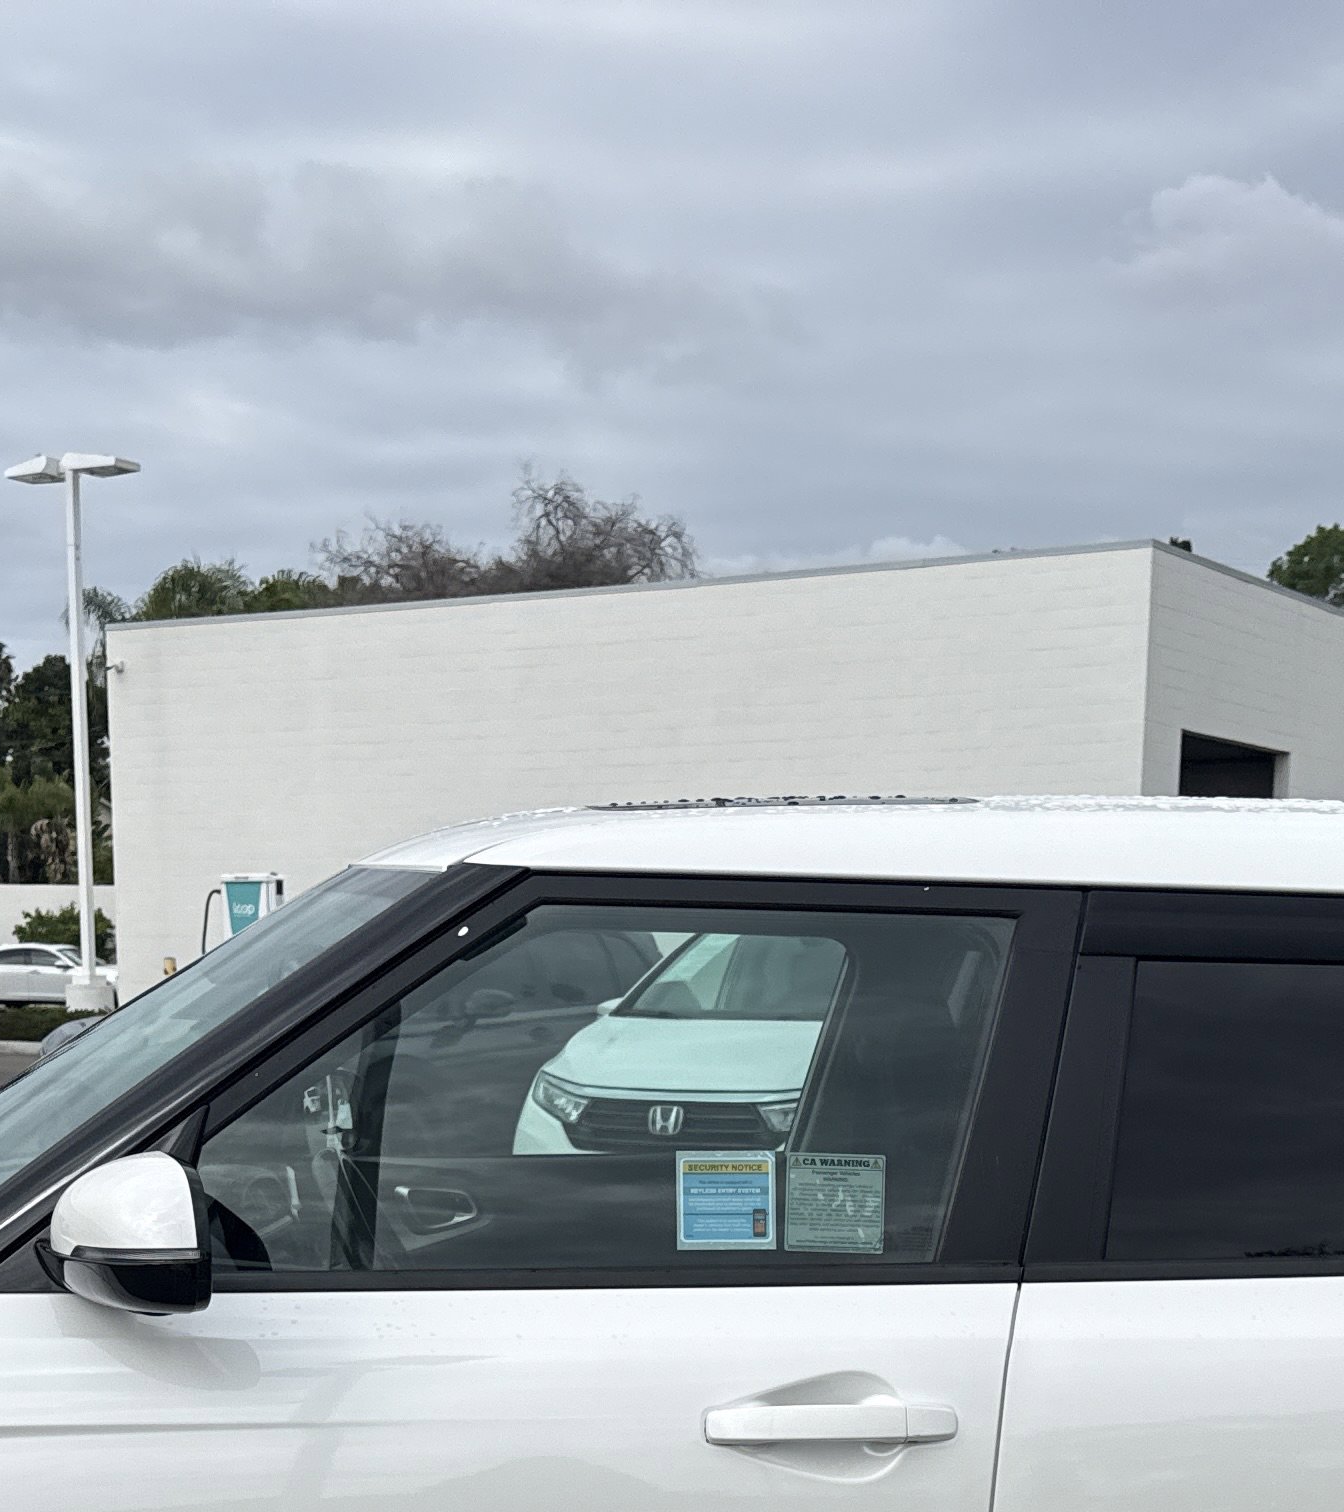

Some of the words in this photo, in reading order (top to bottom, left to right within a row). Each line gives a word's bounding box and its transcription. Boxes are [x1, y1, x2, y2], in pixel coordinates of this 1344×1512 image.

[802, 1158, 817, 1166] CA
[819, 1159, 871, 1168] WARNING
[688, 1164, 730, 1172] SECURITY
[731, 1164, 763, 1172] NOTICE
